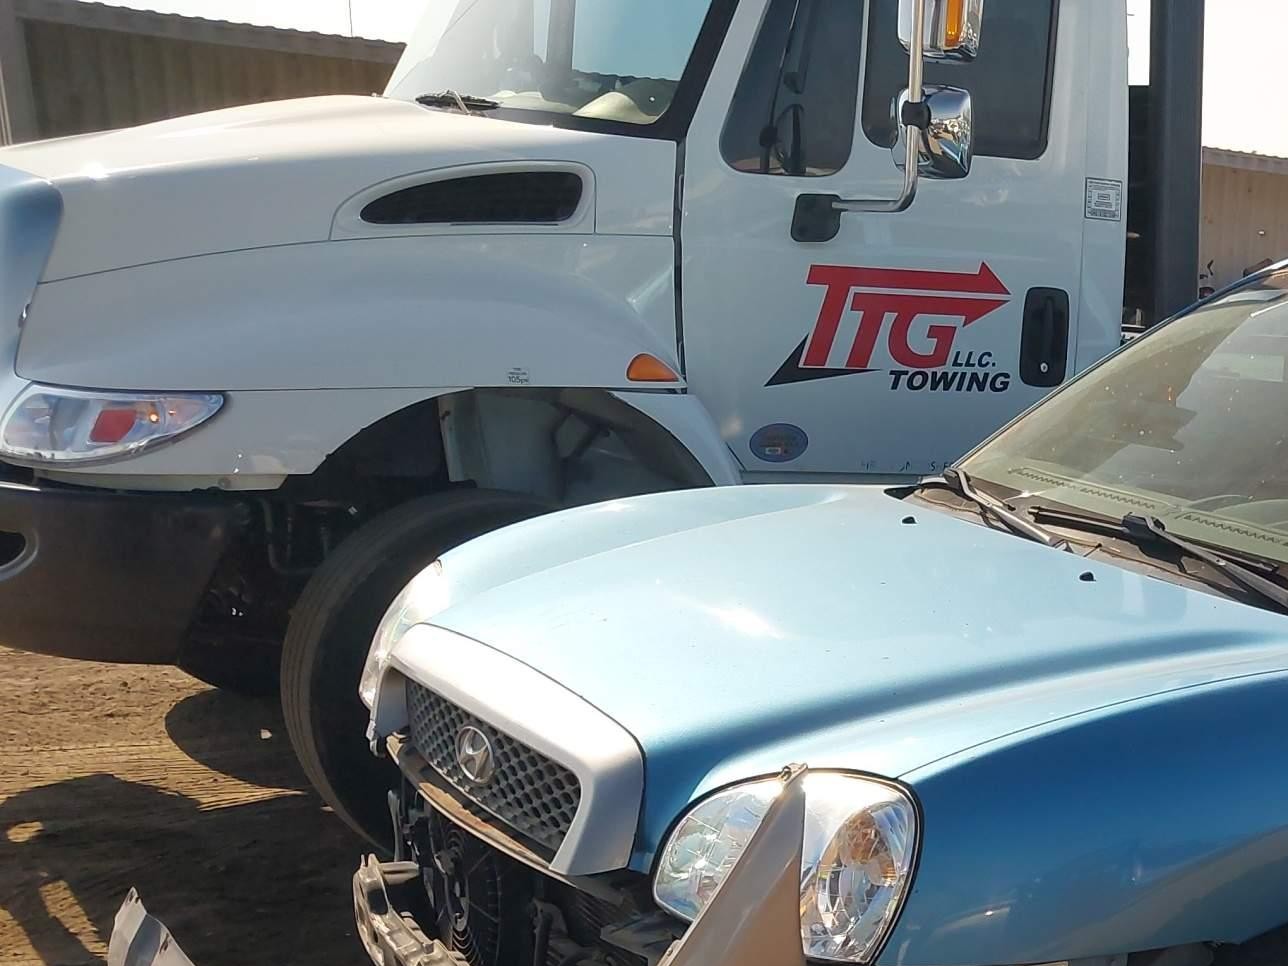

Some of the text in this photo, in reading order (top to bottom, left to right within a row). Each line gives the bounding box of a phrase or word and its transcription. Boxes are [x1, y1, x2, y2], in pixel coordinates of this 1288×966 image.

[802, 262, 1011, 369] TTG LLC.
[888, 370, 1011, 393] TOWING
